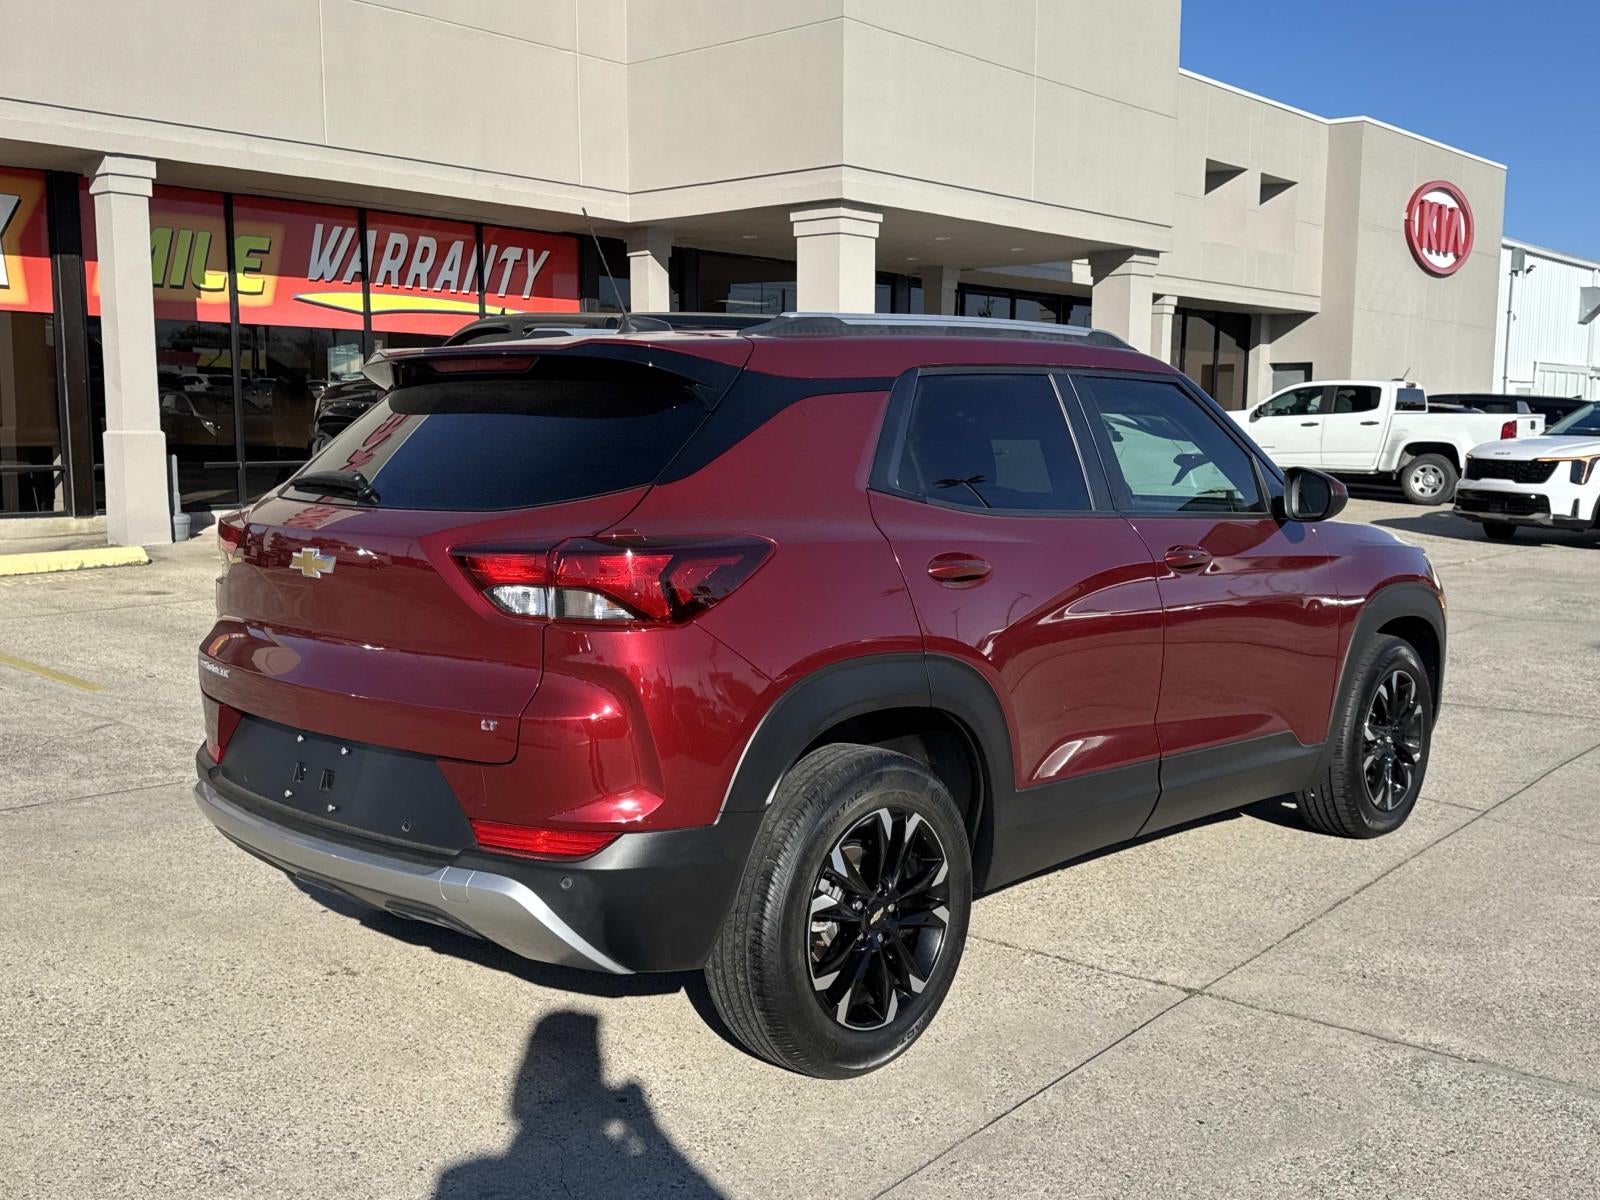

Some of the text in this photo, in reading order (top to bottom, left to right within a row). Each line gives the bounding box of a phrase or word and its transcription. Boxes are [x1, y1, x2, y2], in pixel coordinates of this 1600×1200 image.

[1417, 199, 1464, 257] KIA
[307, 223, 550, 299] WARRANTY
[480, 719, 498, 731] LT
